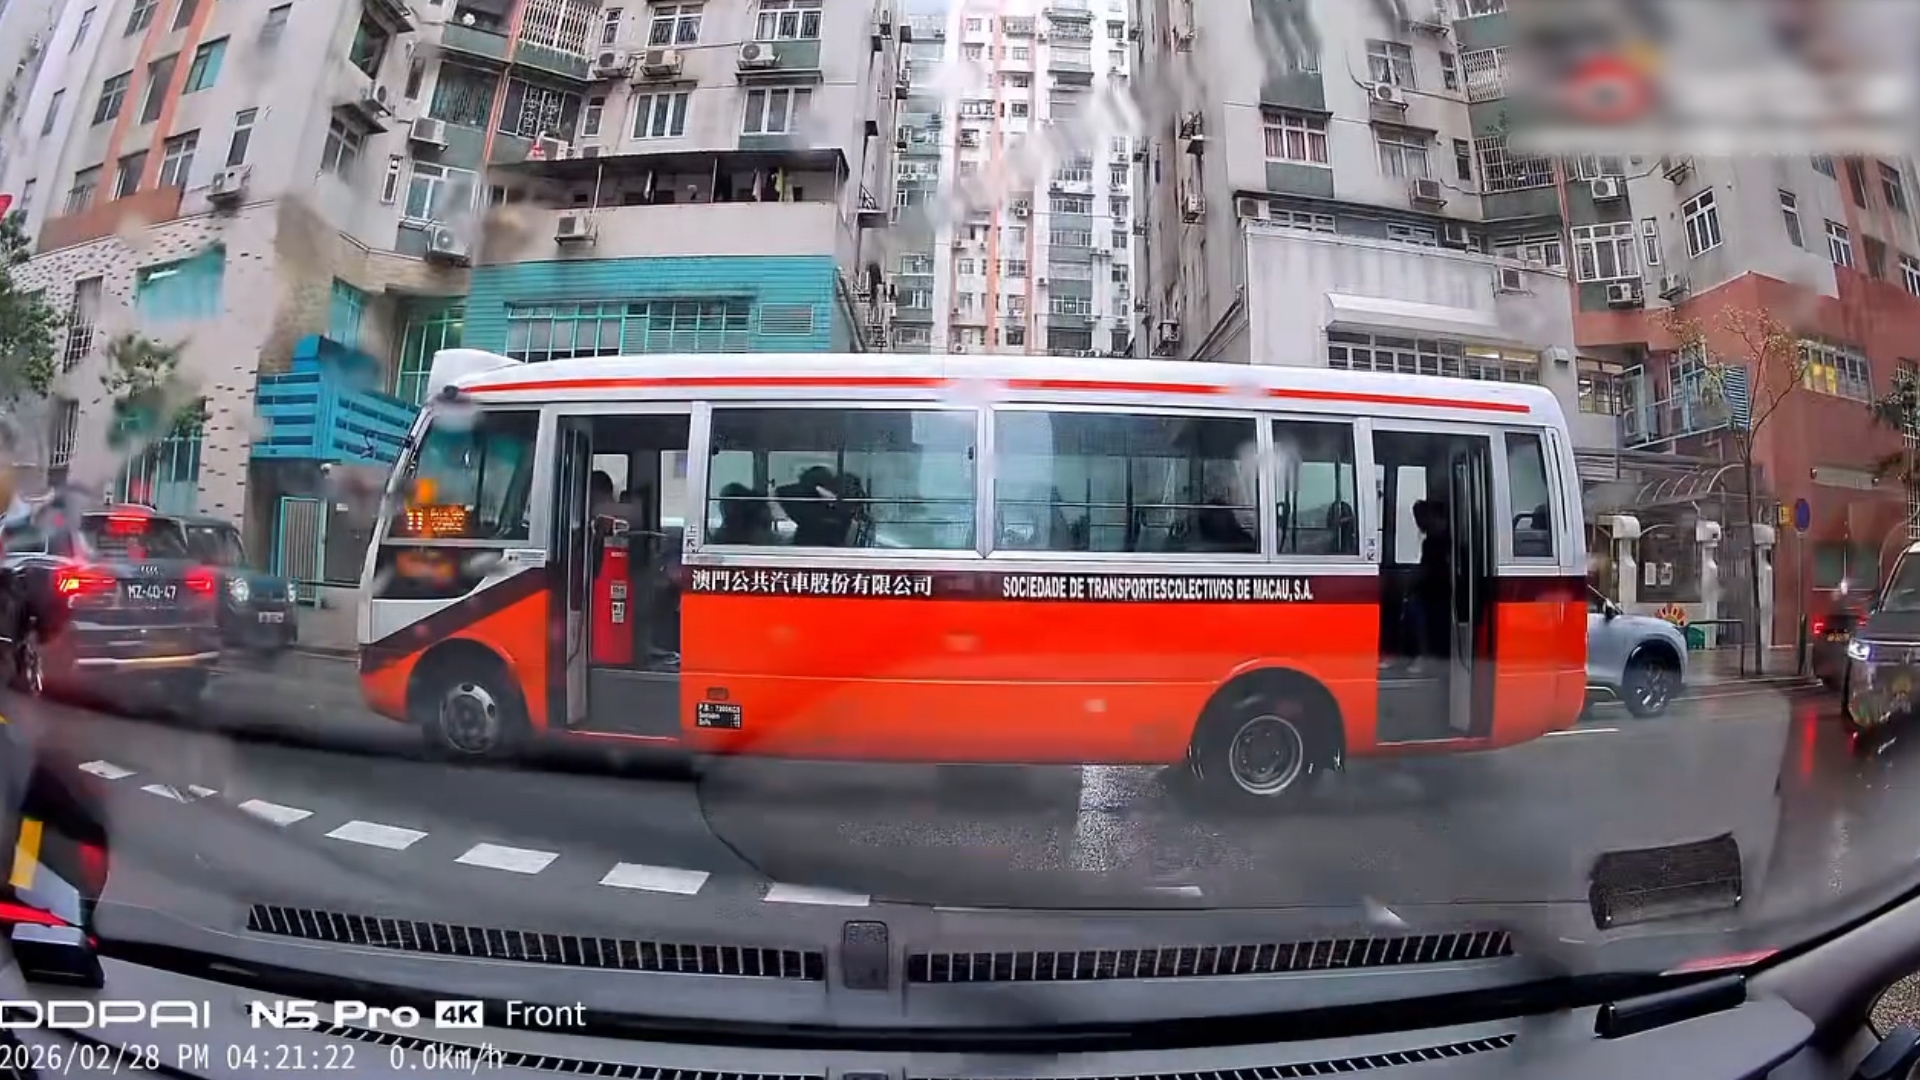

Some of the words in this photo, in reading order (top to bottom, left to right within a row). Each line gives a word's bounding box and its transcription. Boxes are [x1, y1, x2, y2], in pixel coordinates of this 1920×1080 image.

[692, 569, 933, 597] 澳門公共汽車股份有限公司
[1003, 576, 1067, 598] SOCIEDADE
[1069, 577, 1085, 598] DE
[1236, 579, 1251, 600] DE
